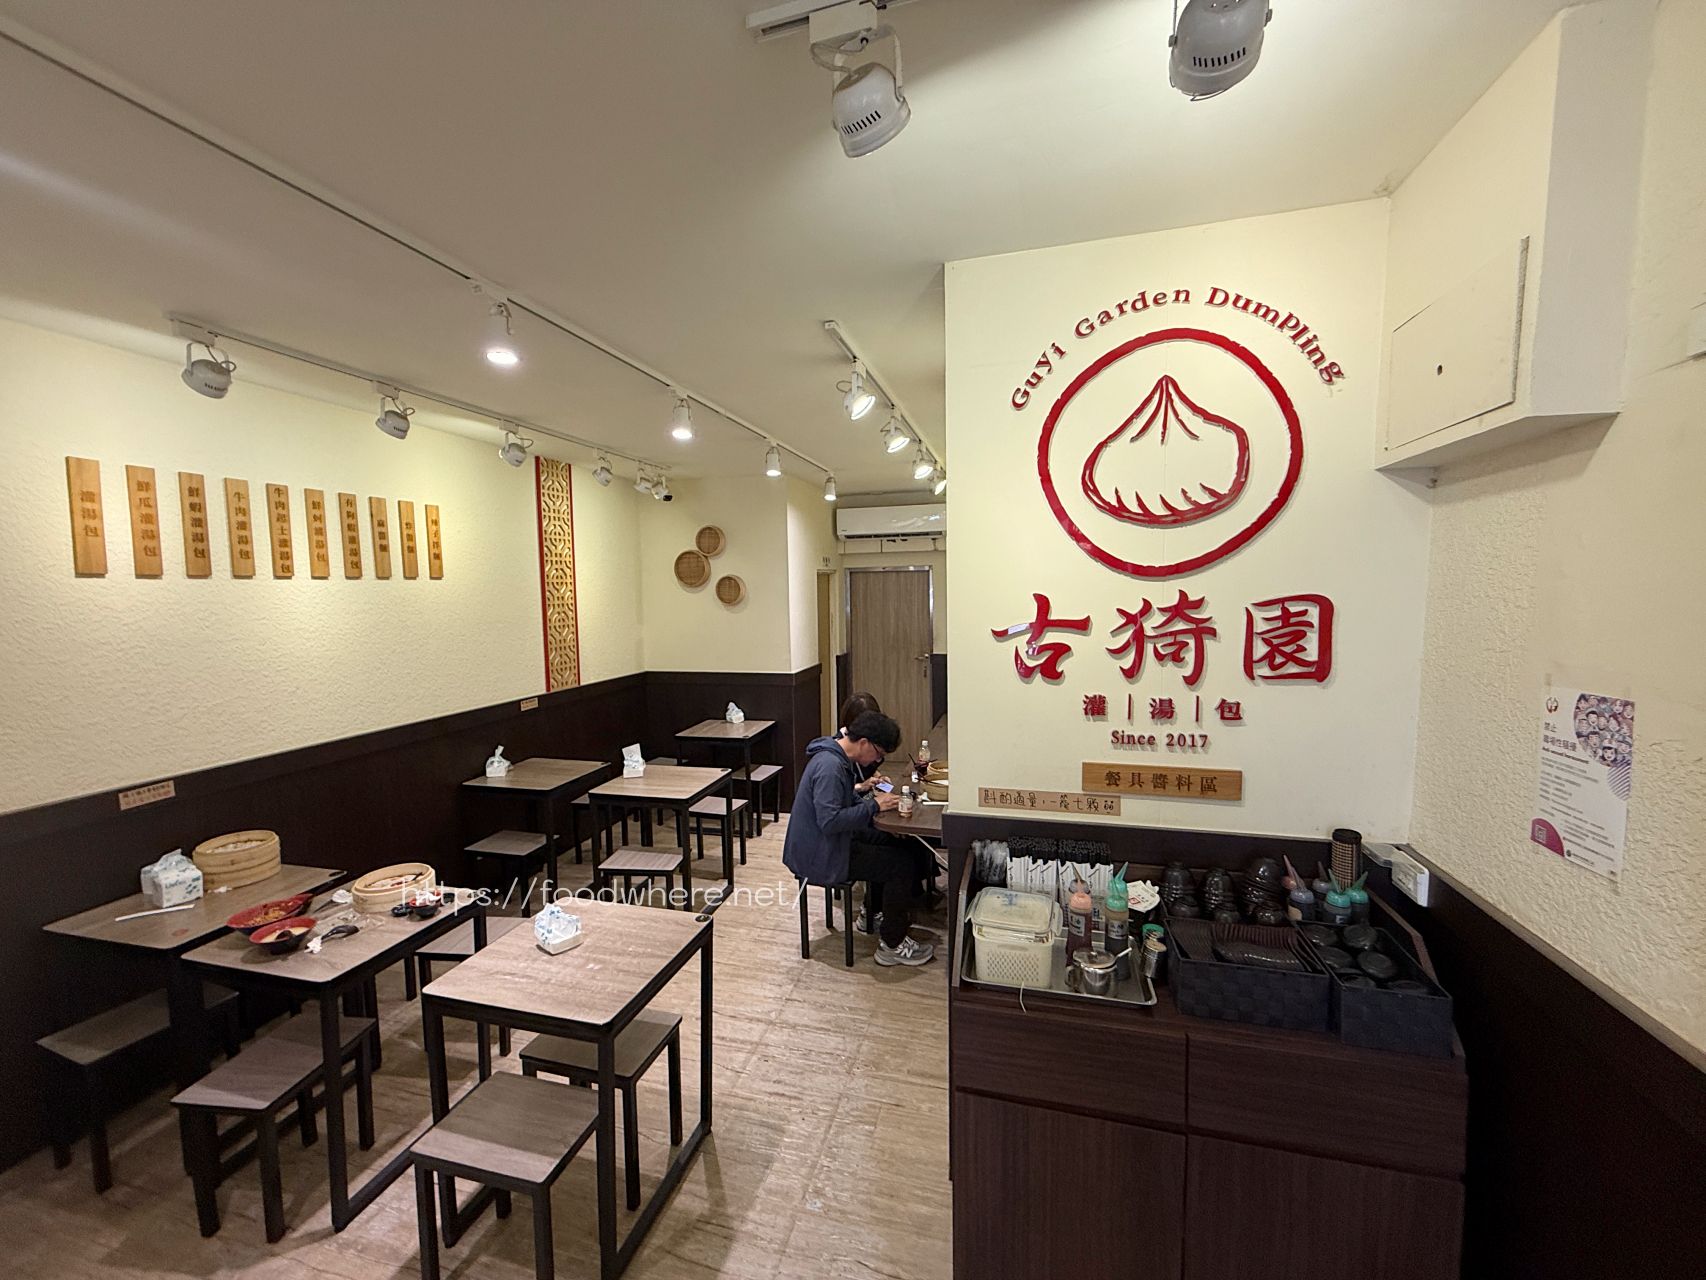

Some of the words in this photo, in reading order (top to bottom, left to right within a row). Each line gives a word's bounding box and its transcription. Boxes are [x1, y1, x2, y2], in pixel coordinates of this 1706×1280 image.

[1011, 342, 1067, 410] Guyi
[1074, 288, 1191, 338] Garden
[1204, 286, 1345, 385] Dumpling
[80, 490, 98, 537] 灌湯包
[187, 486, 206, 559] 鮮蝦灌湯包
[233, 491, 251, 560] 牛肉灌湯包
[274, 487, 291, 574] 牛肉起士灌湯包
[991, 589, 1334, 686] 古猗園
[1111, 730, 1156, 746] Since
[1166, 733, 1208, 748] 2017
[1105, 770, 1218, 794] 餐具醬料區
